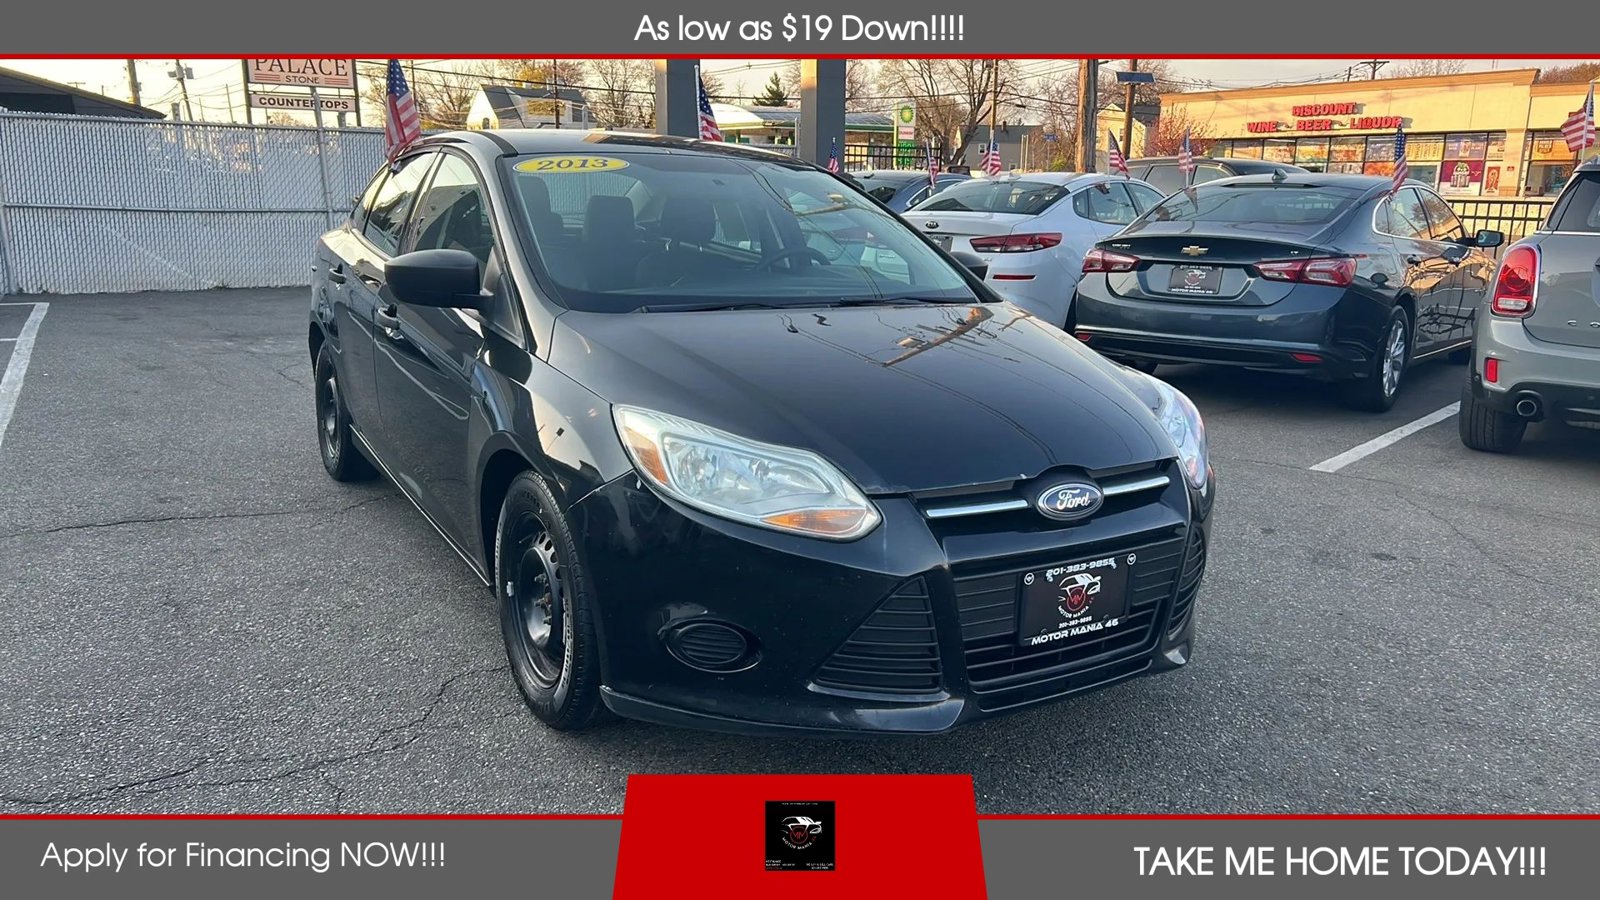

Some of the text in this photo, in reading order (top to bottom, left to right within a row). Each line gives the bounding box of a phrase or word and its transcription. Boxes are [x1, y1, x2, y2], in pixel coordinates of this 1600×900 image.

[254, 59, 348, 77] PALACE
[285, 75, 320, 85] STONE
[1291, 102, 1357, 117] DISCOUNT
[1247, 120, 1279, 133] WINE
[1296, 118, 1333, 131] BEER
[536, 159, 609, 171] 2013
[1056, 489, 1091, 510] Ford
[1031, 618, 1119, 646] MOTOR MANIA 46
